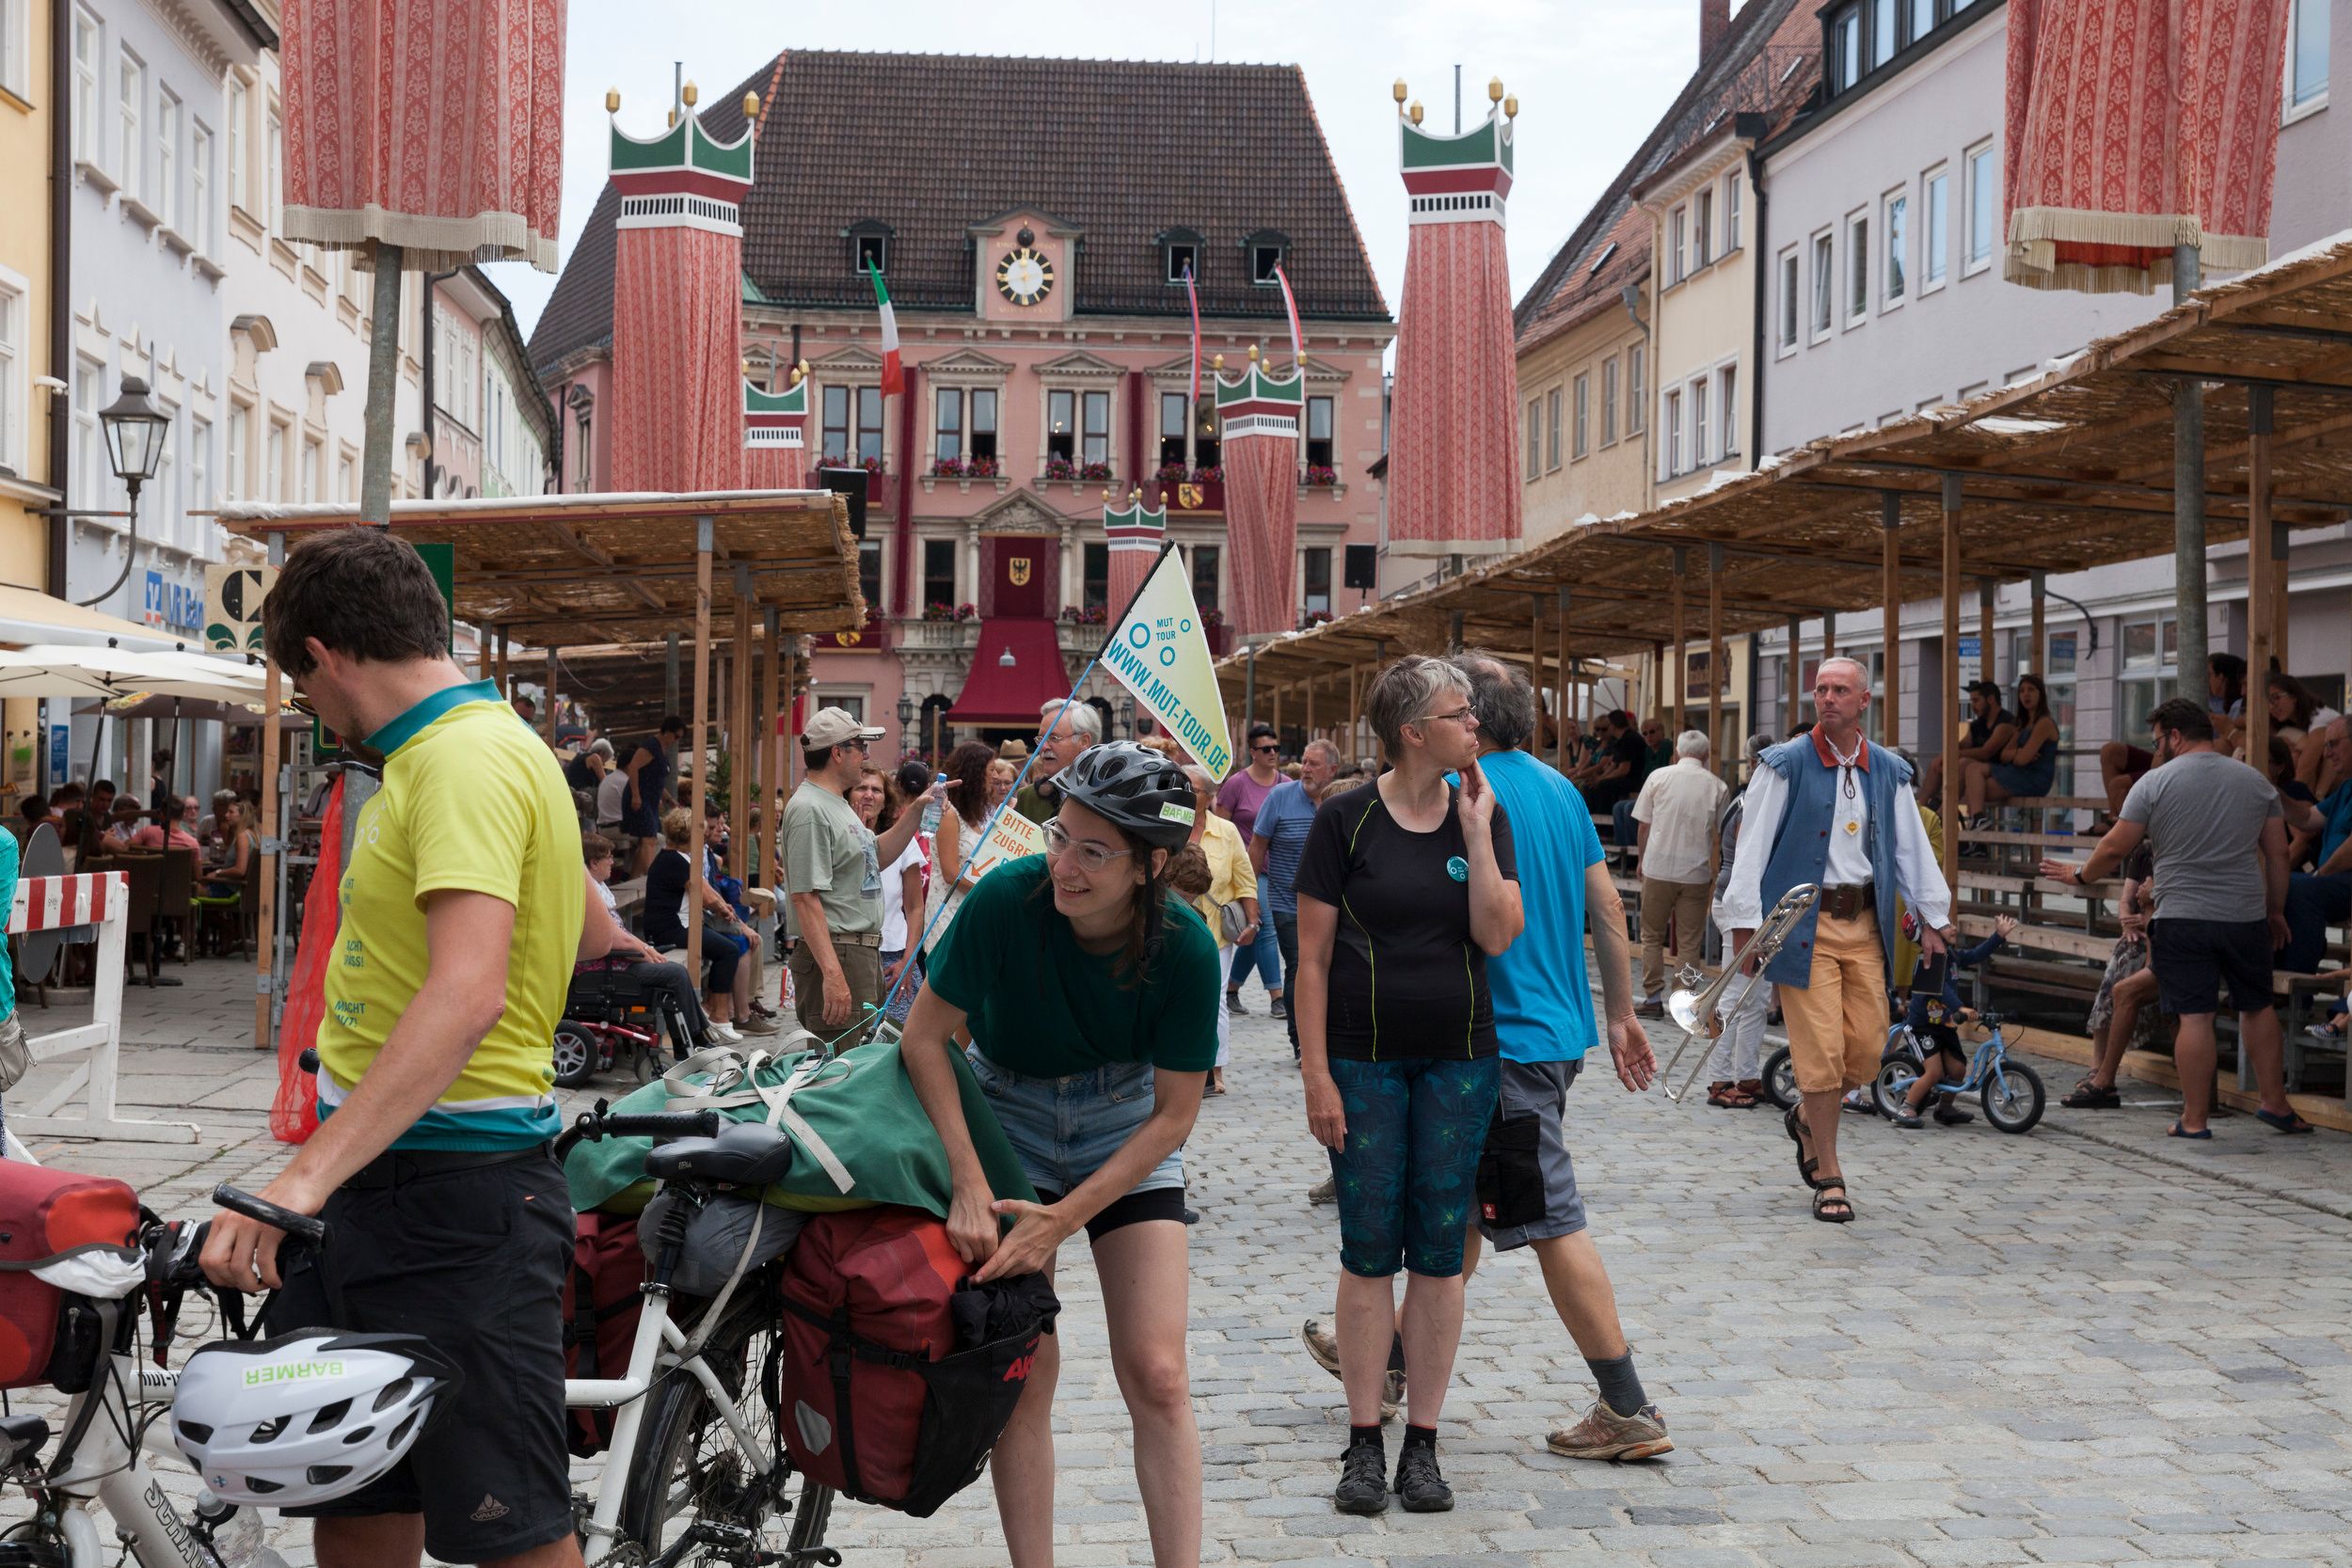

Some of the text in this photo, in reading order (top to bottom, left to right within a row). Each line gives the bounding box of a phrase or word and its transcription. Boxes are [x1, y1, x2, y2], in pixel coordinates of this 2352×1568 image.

[167, 582, 182, 626] VR
[1156, 617, 1174, 627] MUT
[1156, 630, 1176, 641] TOUR
[1106, 638, 1229, 775] WWW.MUT-TOUR.DE
[1002, 812, 1036, 840] BITTE
[993, 830, 1036, 858] ZUGRE
[246, 1361, 344, 1386] BARMER
